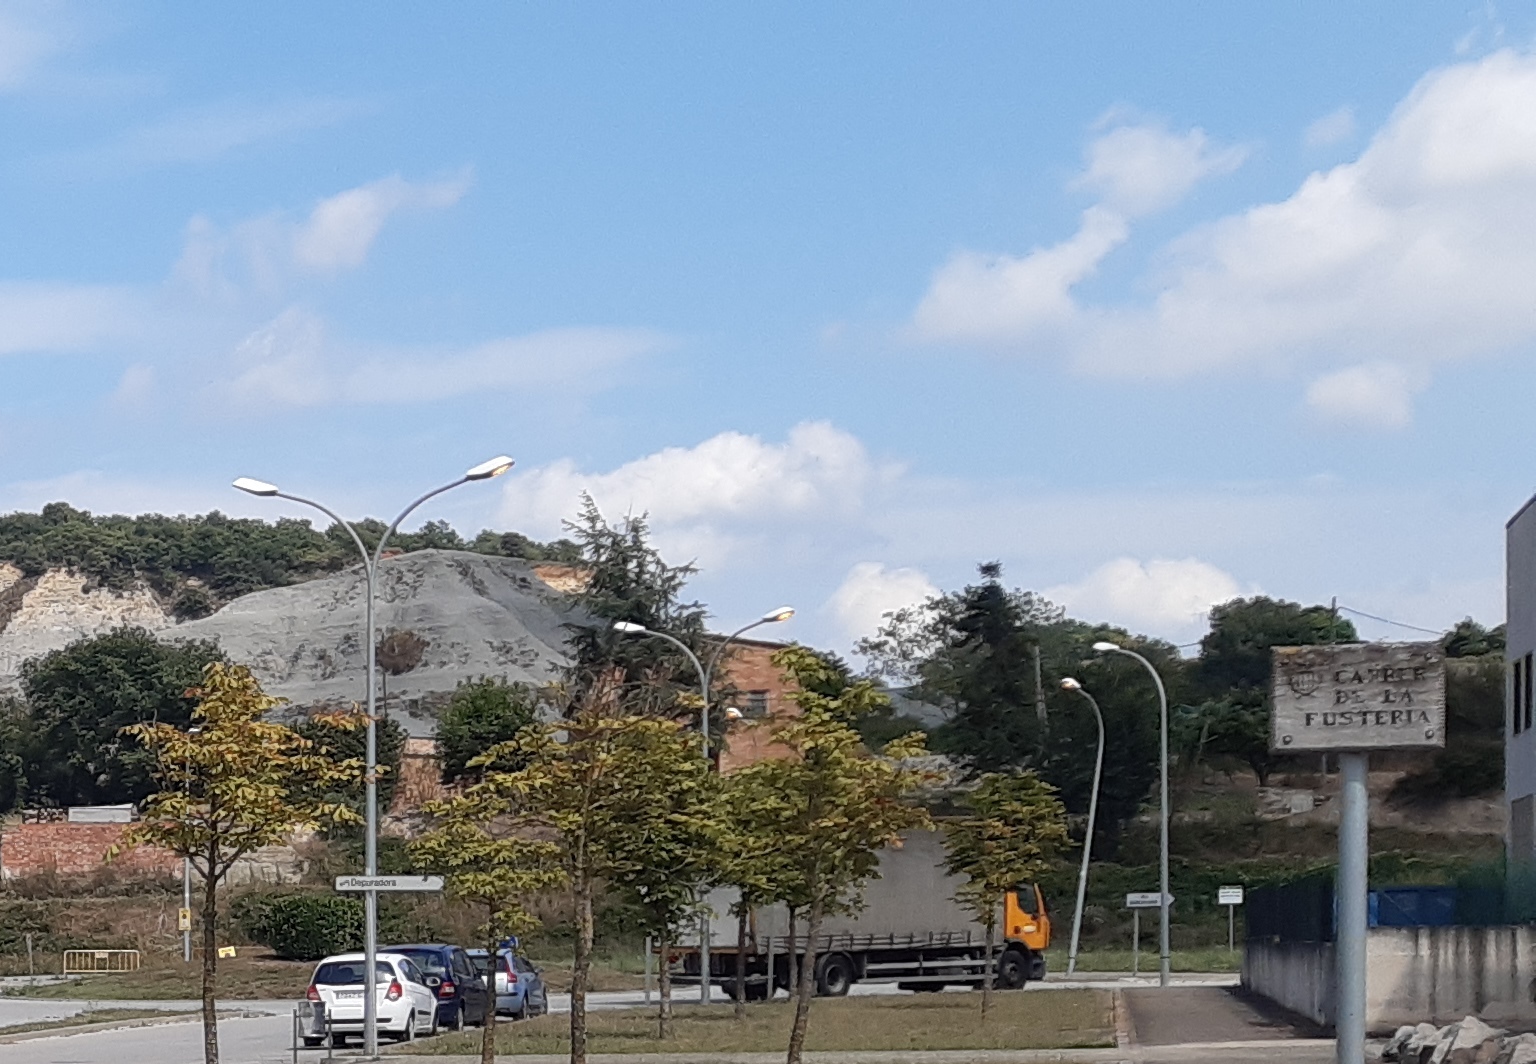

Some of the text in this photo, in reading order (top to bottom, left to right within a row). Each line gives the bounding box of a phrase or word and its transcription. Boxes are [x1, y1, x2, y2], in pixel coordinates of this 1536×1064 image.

[1334, 667, 1426, 684] CARRER
[1334, 689, 1414, 705] DE LA
[1305, 709, 1431, 726] FUSTERIA
